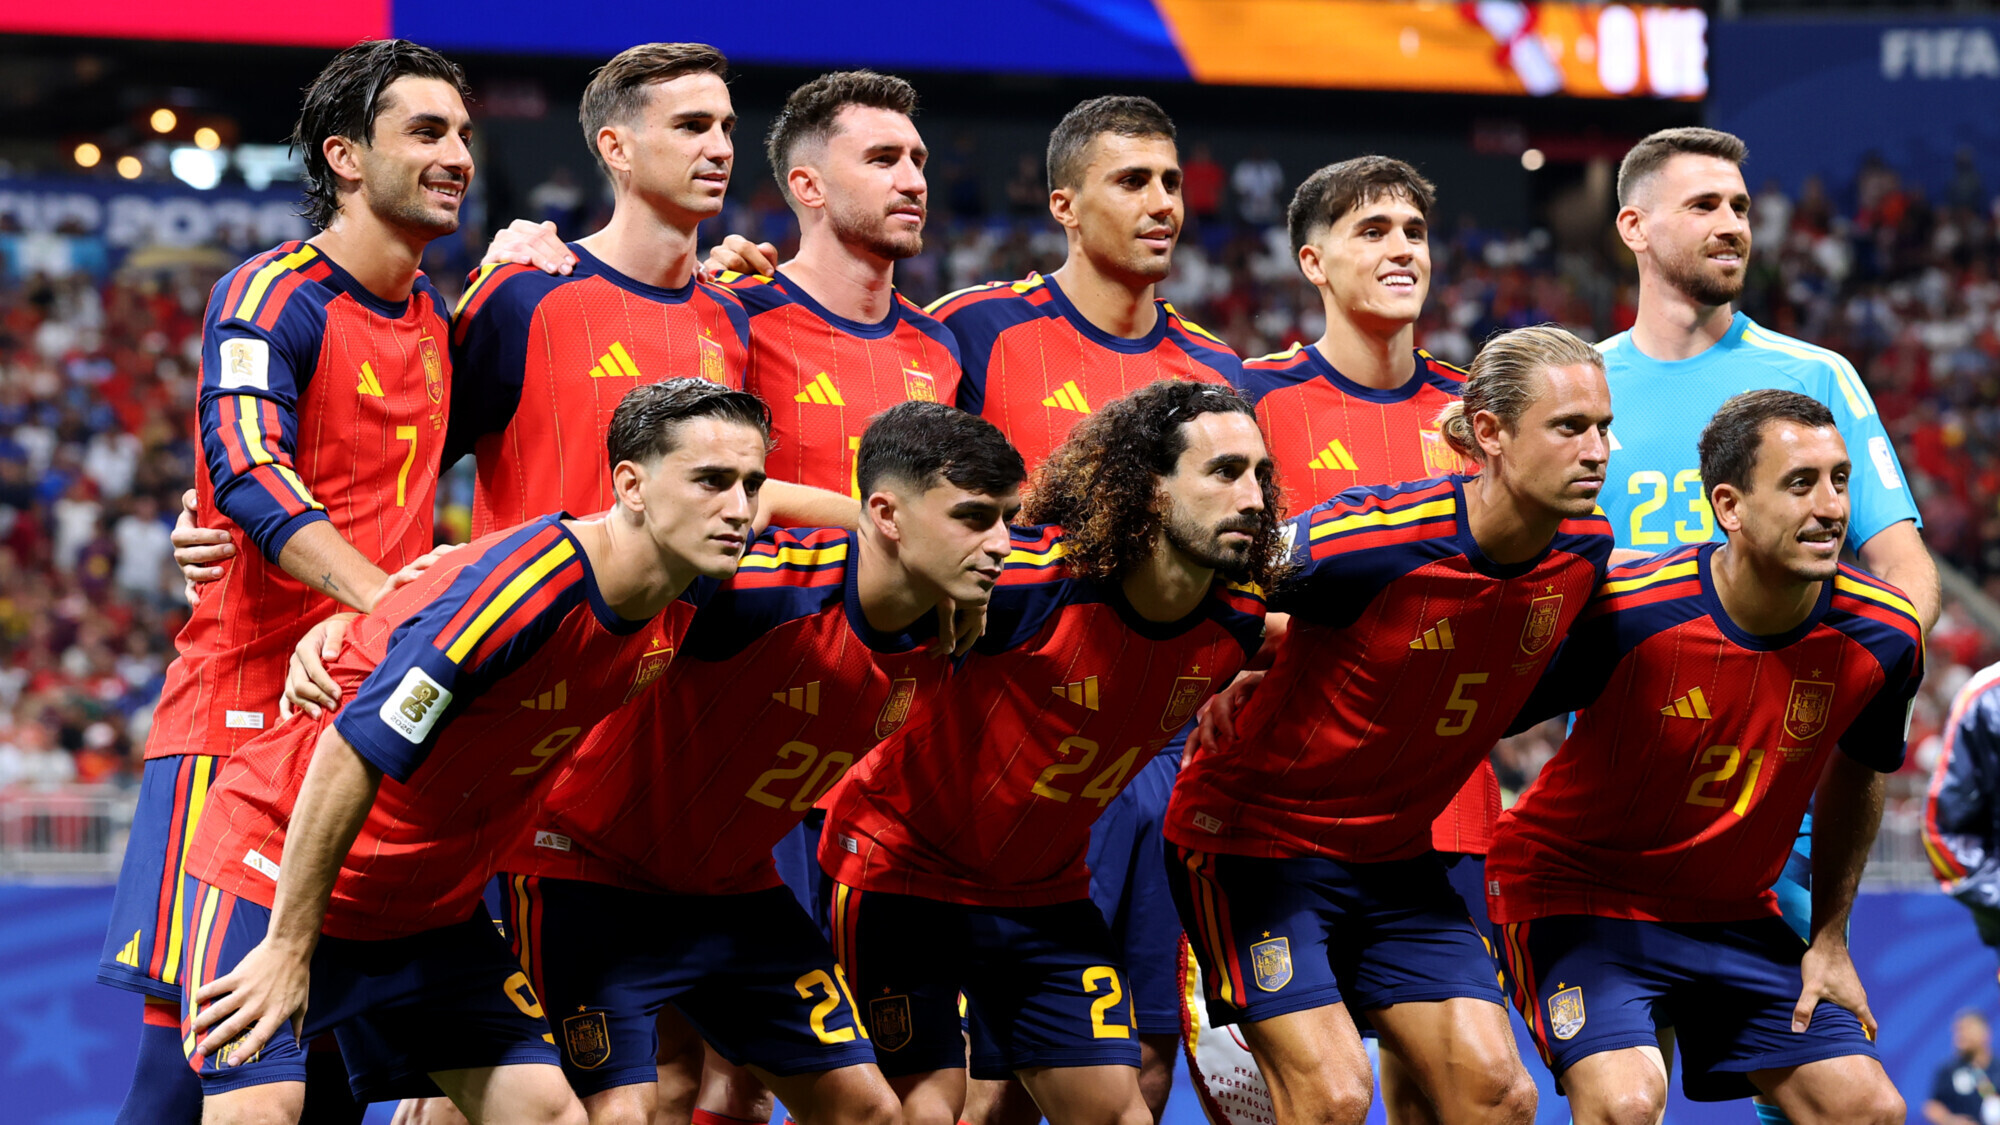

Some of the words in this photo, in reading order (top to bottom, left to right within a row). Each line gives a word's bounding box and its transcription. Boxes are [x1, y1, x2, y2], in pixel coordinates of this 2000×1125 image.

[1881, 28, 2000, 79] FIFA
[396, 425, 417, 507] 7
[1628, 469, 1714, 546] 23
[390, 715, 413, 735] 2026
[1435, 672, 1489, 736] 5
[510, 726, 581, 776] 9
[744, 740, 854, 812] 20
[1031, 736, 1142, 808] 24
[1685, 745, 1765, 817] 21
[1082, 965, 1138, 1039] 2
[1211, 1075, 1270, 1098] FEDERACIÓ
[1218, 1090, 1273, 1113] ESPAÑOLA
[1234, 1066, 1258, 1081] REAL
